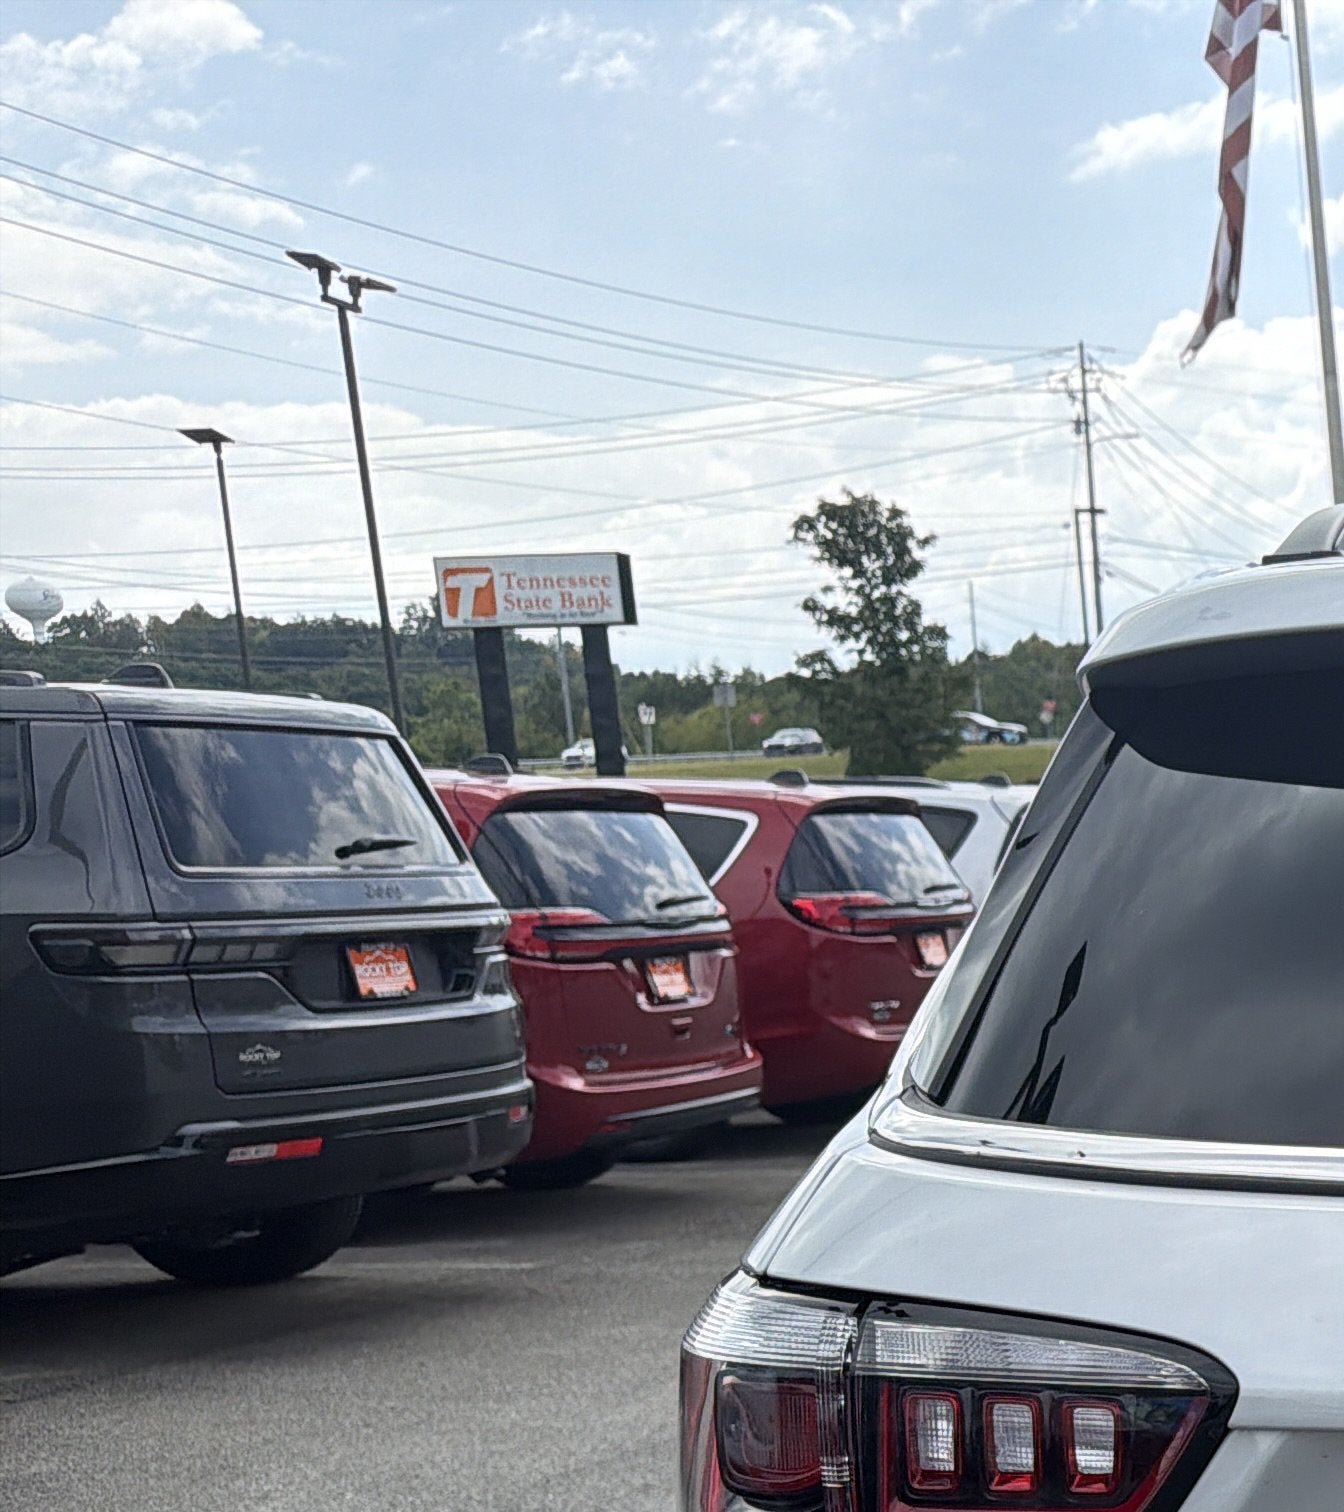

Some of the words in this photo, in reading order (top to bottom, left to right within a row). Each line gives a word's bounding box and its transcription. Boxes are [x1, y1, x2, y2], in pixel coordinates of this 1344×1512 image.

[501, 571, 612, 591] Tennessee
[503, 592, 553, 613] State
[559, 588, 613, 614] Bank
